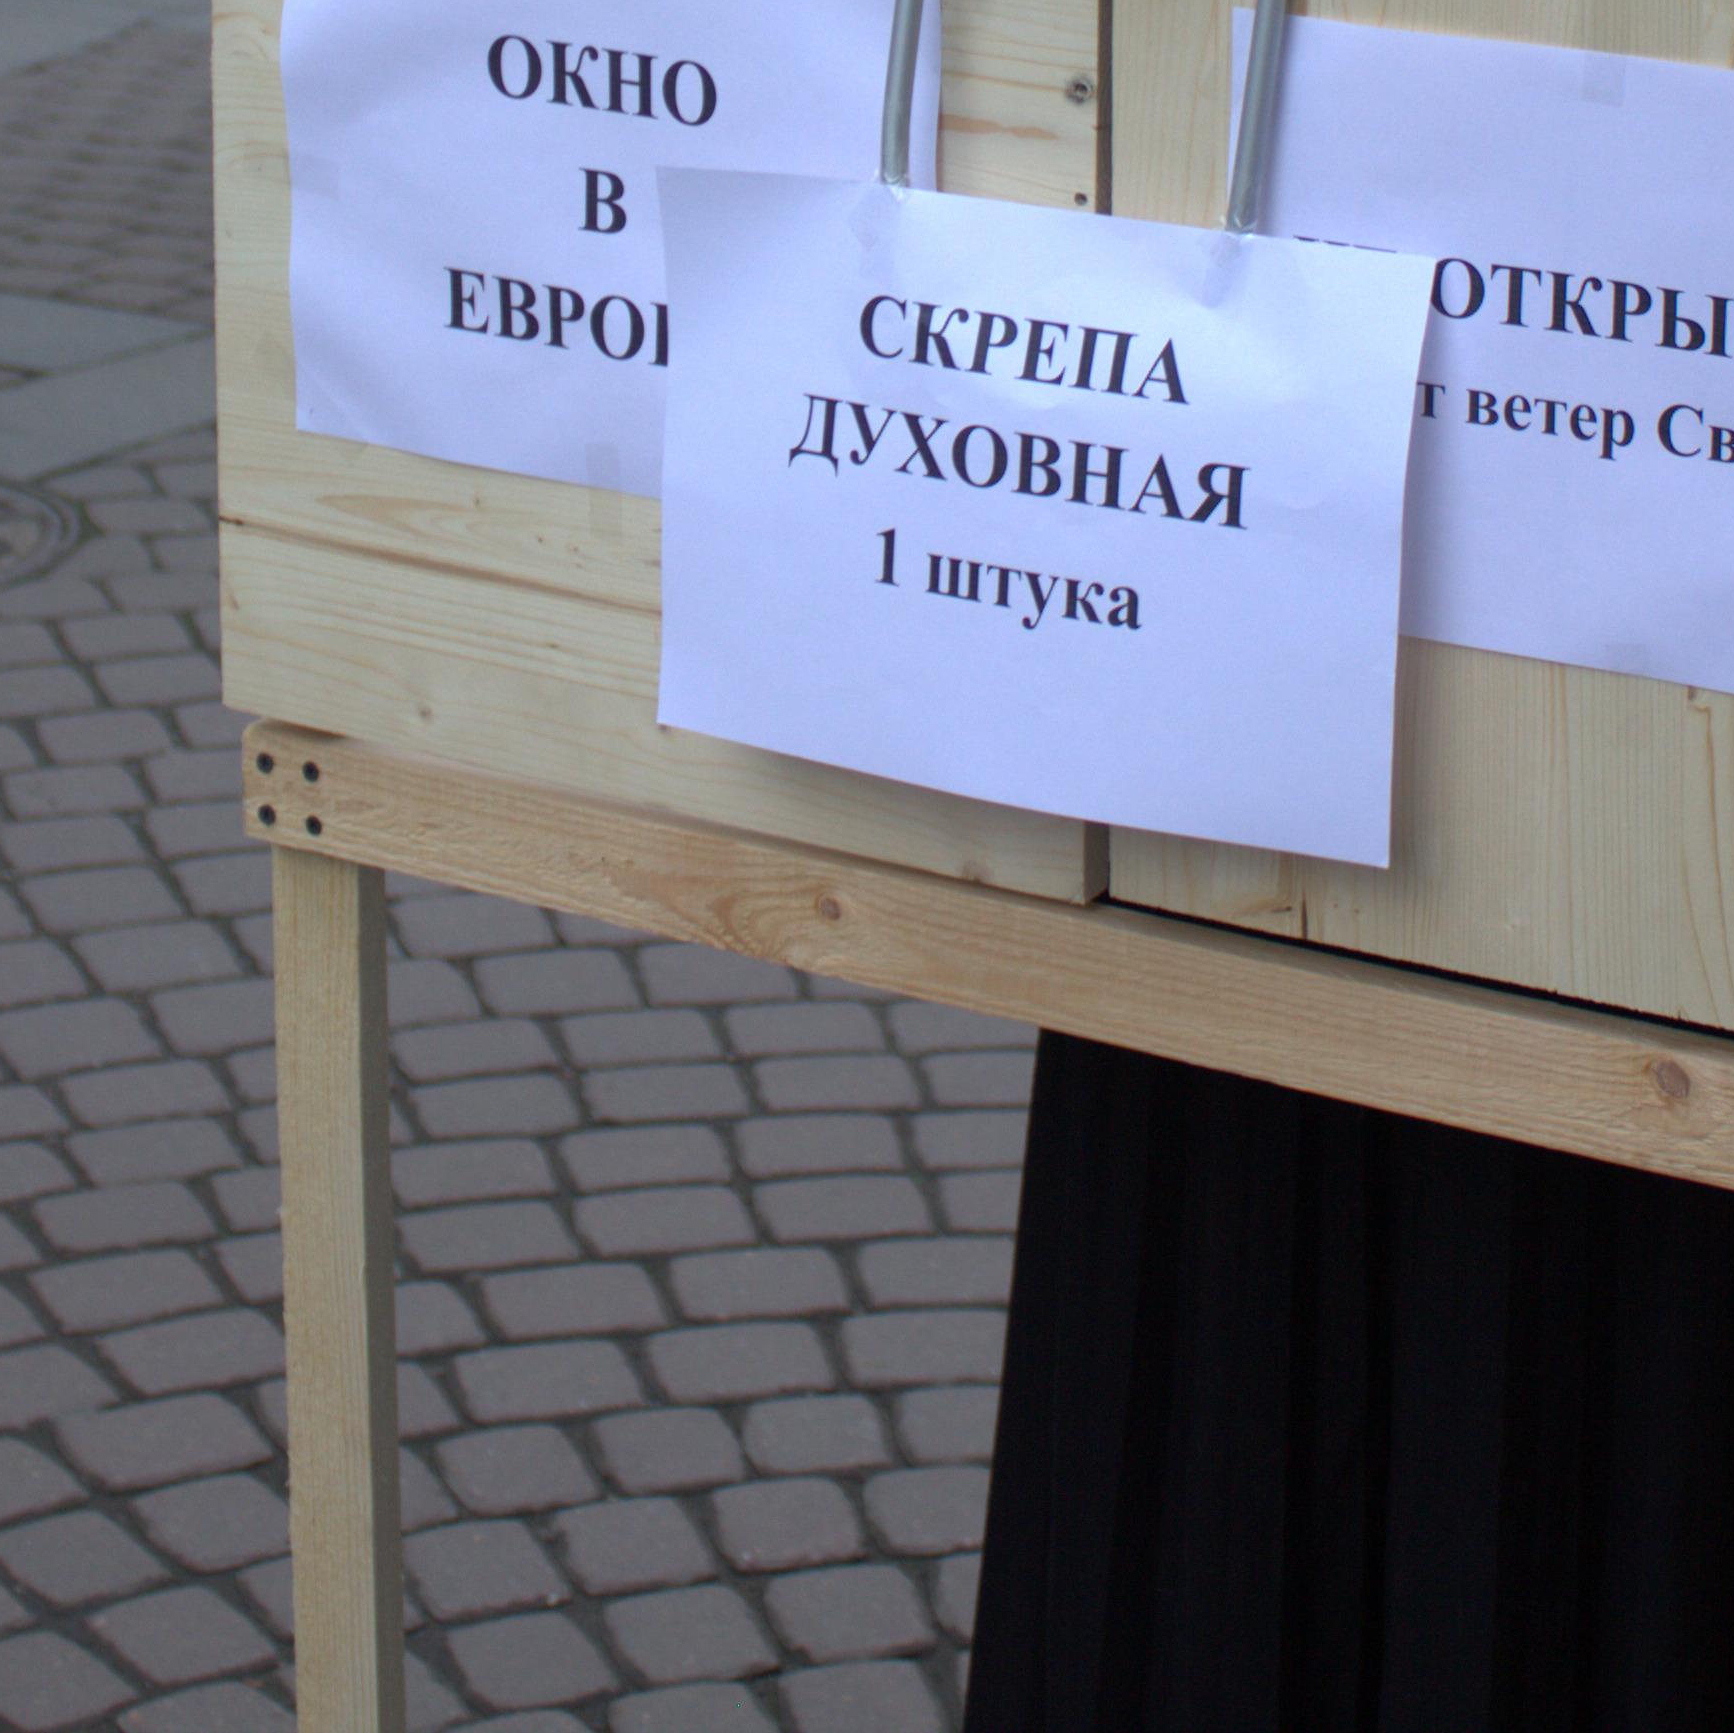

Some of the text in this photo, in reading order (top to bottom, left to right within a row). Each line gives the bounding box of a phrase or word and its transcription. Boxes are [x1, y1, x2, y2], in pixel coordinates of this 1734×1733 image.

[486, 33, 718, 128] ОКНО
[581, 167, 628, 235] В
[859, 294, 1188, 405] СКРЕПА
[788, 392, 1248, 530] ДУХОВНАЯ
[1465, 388, 1636, 462] ветер
[875, 527, 1143, 631] 1 штука
